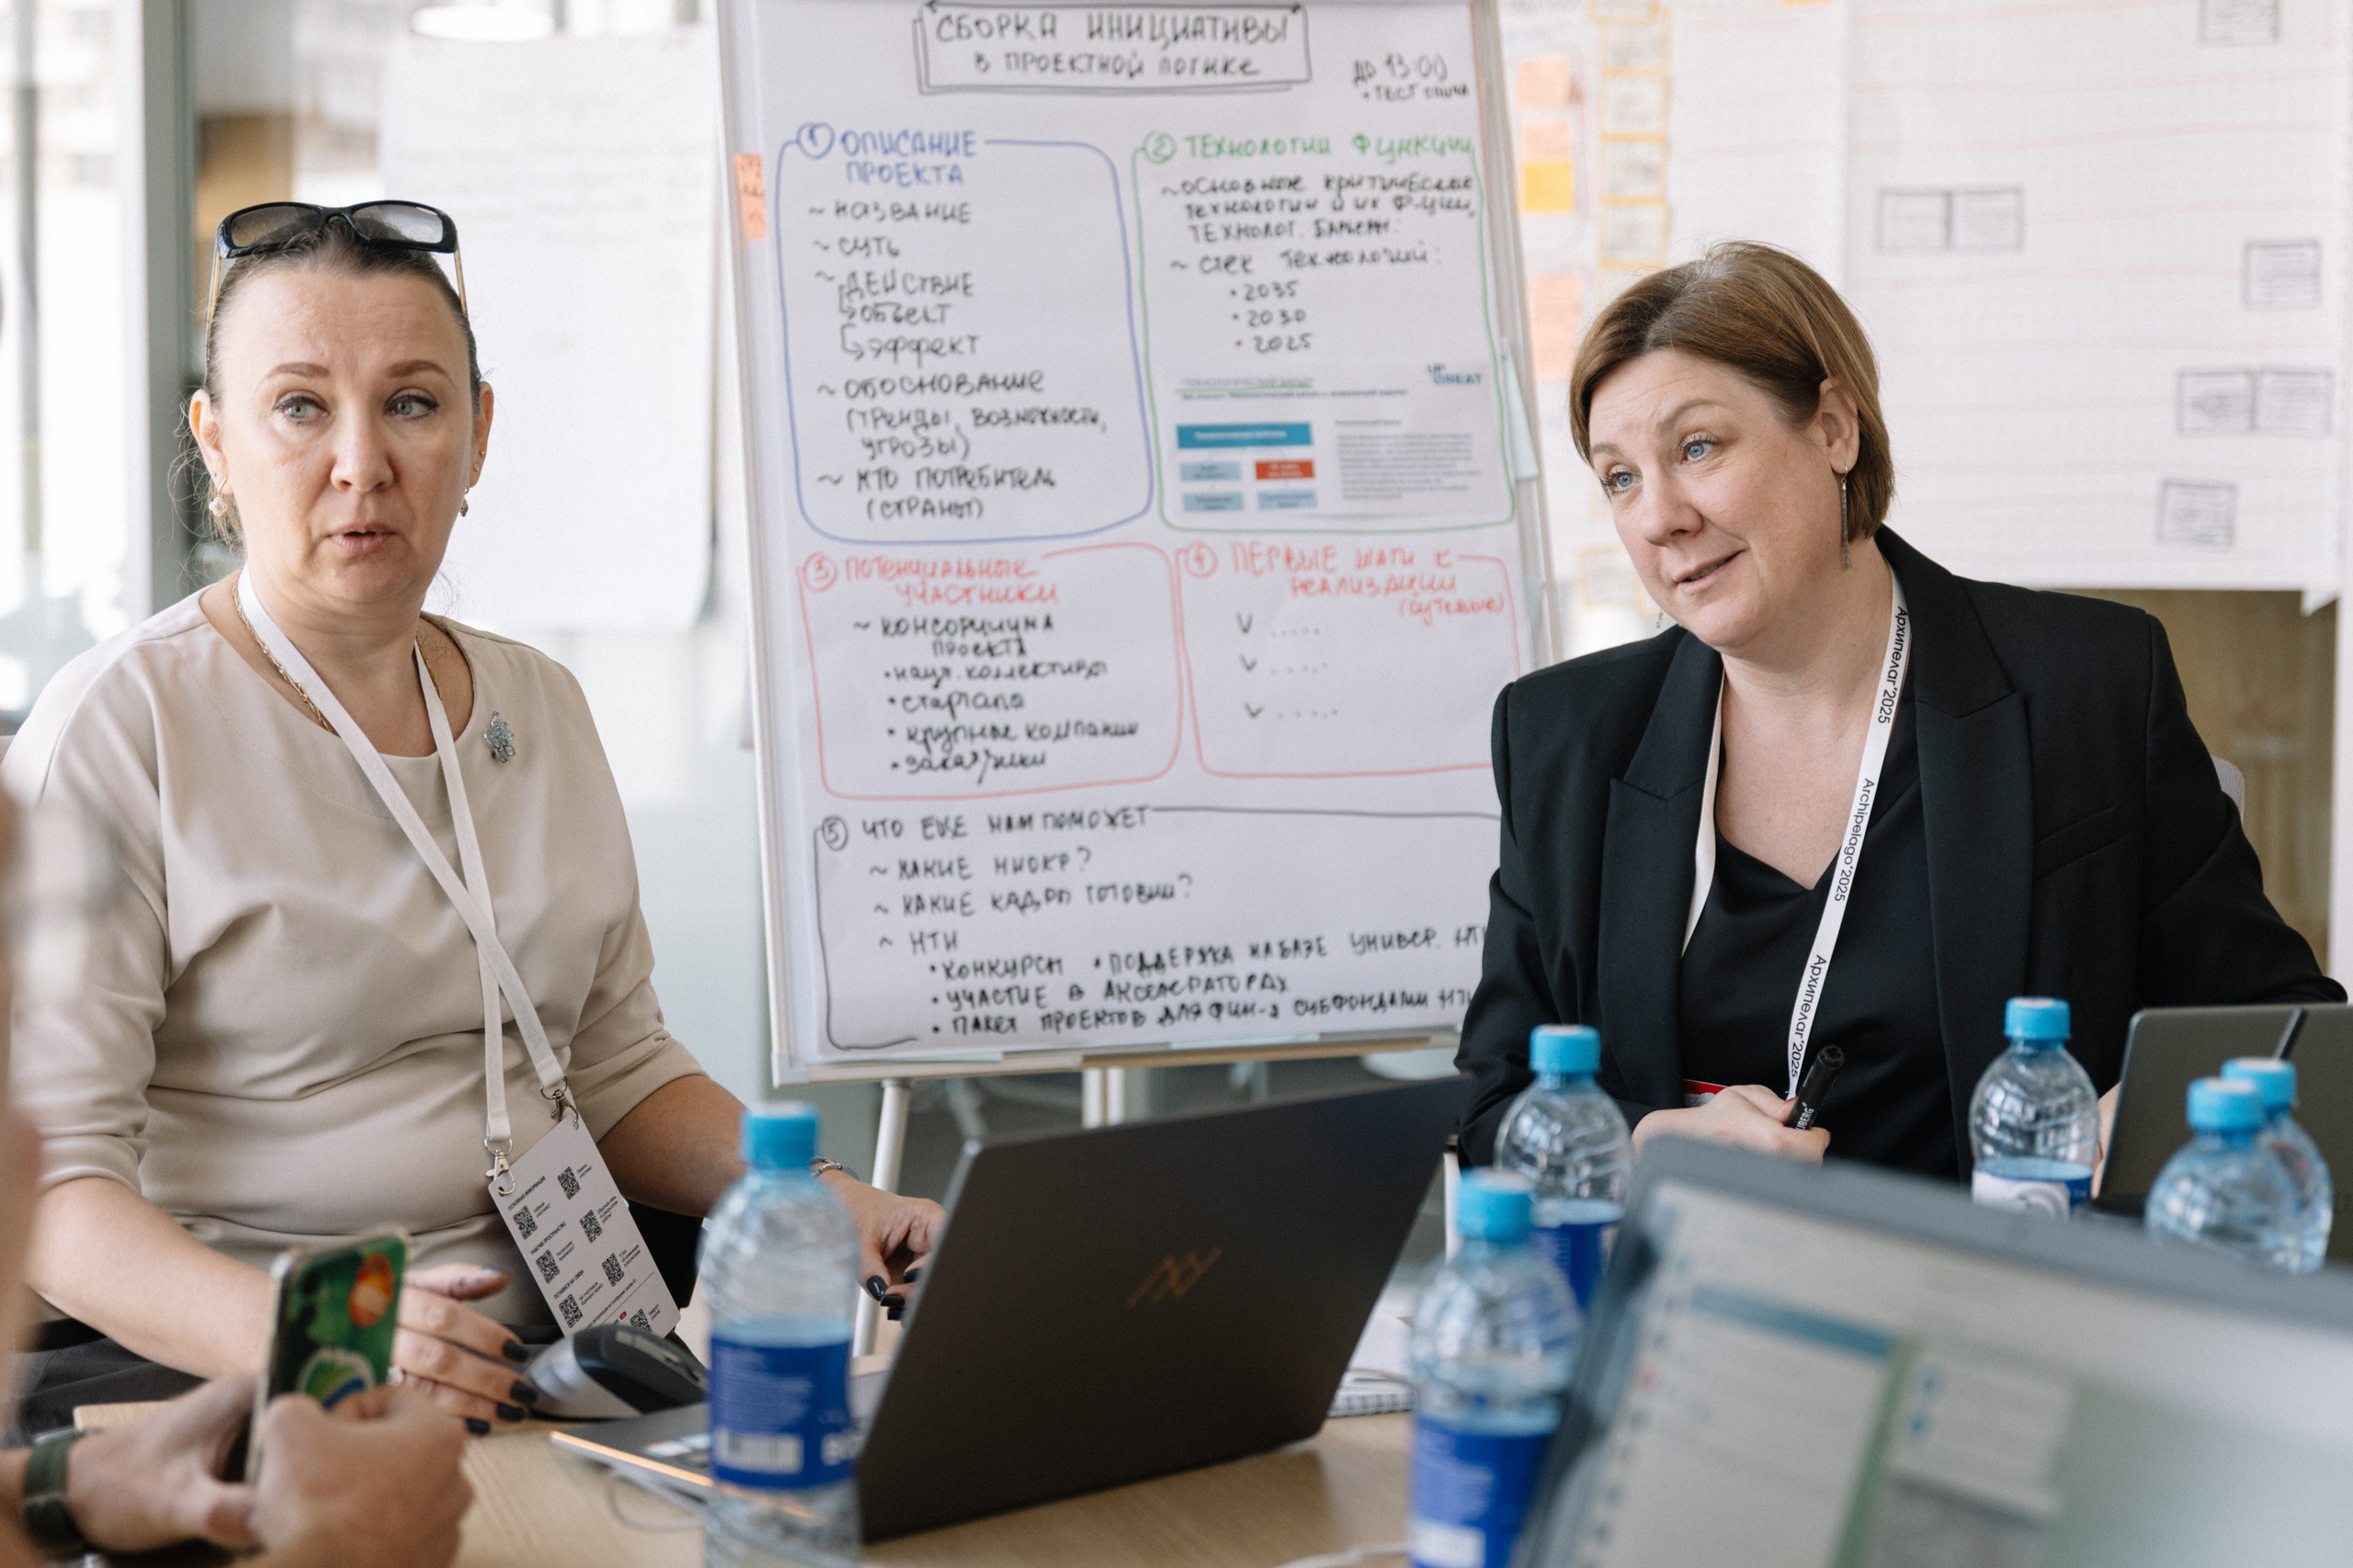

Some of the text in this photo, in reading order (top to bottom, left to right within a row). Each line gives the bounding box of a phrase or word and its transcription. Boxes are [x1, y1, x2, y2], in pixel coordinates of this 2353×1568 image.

[938, 10, 1289, 50] СБОРКА ИНИЦИАТИВЫ
[1007, 51, 1145, 79] ПРОЕКТНОЙ
[840, 129, 977, 158] ОПИСАНИЕ
[1184, 132, 1332, 160] ТЕХНОЛОГИИ
[846, 160, 965, 187] ПРОЕКТА
[844, 268, 975, 303] ДЕЙСТВИЕ
[856, 467, 899, 494] КТО
[1231, 540, 1339, 576] ПЕРВЫЕ
[861, 815, 904, 841] ЧТО
[988, 814, 1034, 835] НАМ
[898, 857, 973, 881] КАКИЕ
[902, 892, 976, 918] КАКИЕ
